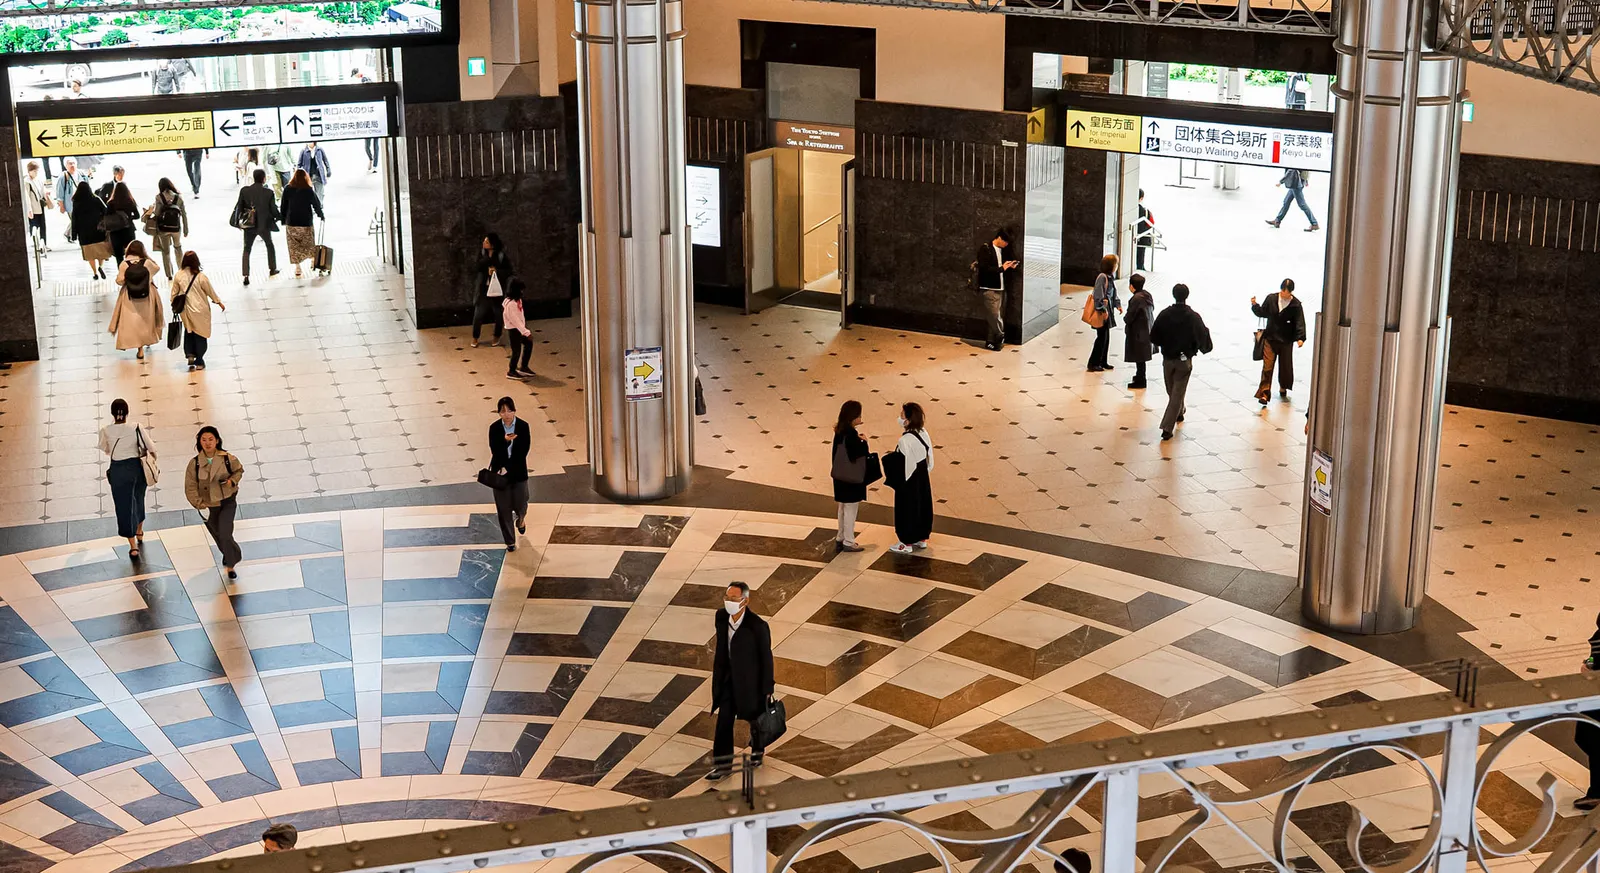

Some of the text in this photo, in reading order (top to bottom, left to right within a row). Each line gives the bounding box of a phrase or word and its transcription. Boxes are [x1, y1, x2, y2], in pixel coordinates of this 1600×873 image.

[60, 116, 206, 138] 東京国際フォーラム方面
[243, 126, 274, 136] はとバス
[1090, 116, 1135, 131] 皇居方面
[61, 141, 74, 149] for
[103, 135, 155, 146] International
[158, 134, 185, 143] Forum
[1089, 137, 1111, 146] Palace
[1100, 130, 1127, 139] Imperial
[1175, 125, 1268, 148] 団体集合場所
[1283, 133, 1322, 149] 京葉線
[1174, 143, 1264, 160] Group Waiting Area
[1305, 149, 1322, 159] Line
